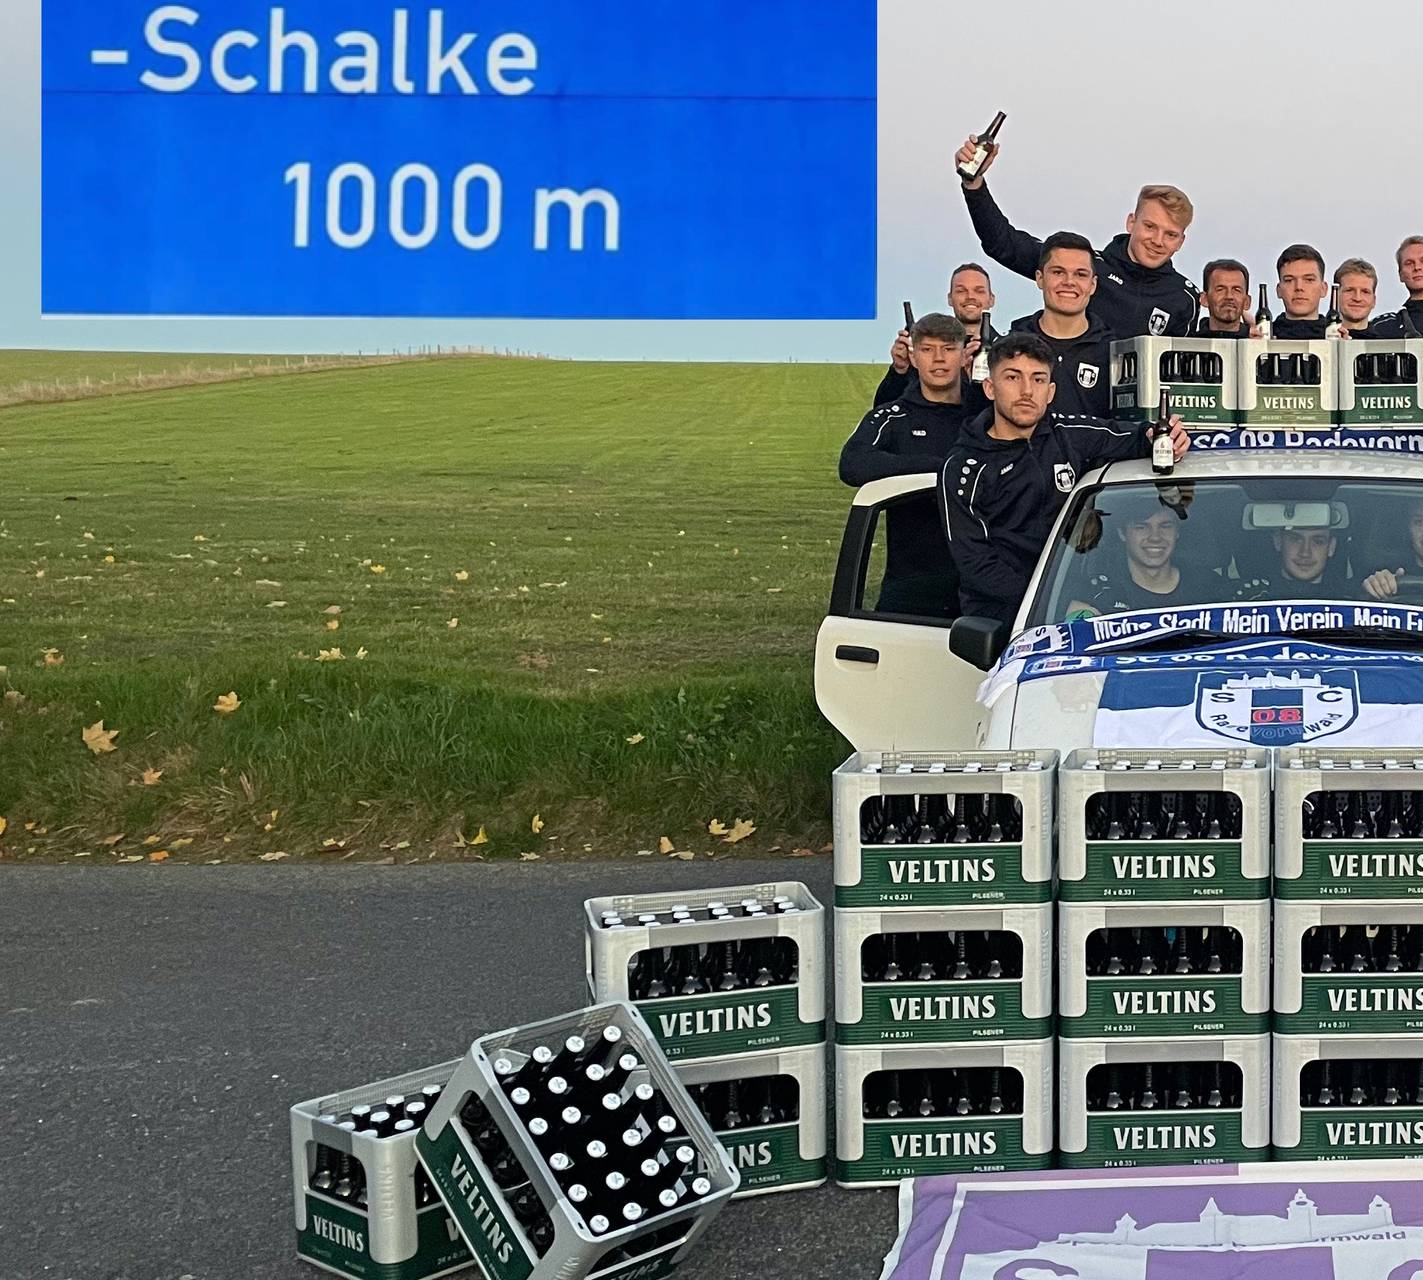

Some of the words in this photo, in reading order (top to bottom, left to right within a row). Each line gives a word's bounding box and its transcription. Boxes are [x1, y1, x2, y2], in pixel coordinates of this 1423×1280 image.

[91, 5, 538, 95] -Schalke
[285, 162, 502, 250] 1000
[534, 188, 619, 251] m
[1168, 395, 1216, 408] VELTINS
[1263, 397, 1314, 409] VELTINS
[1361, 396, 1411, 408] VELTINS
[1222, 608, 1271, 634] Mein
[1276, 606, 1344, 631] Verein
[1210, 692, 1236, 703] S
[1316, 690, 1344, 703] C
[1252, 708, 1302, 723] 08
[888, 859, 996, 883] VELTINS
[1112, 854, 1216, 879] VELTINS
[890, 995, 996, 1021] VELTINS
[1112, 989, 1216, 1015] VELTINS
[658, 1002, 772, 1038] VELTINS
[890, 1131, 997, 1158] VELTINS
[1113, 1124, 1216, 1150] VELTINS
[451, 1153, 513, 1264] VELTINS
[312, 1214, 365, 1253] VELTINS
